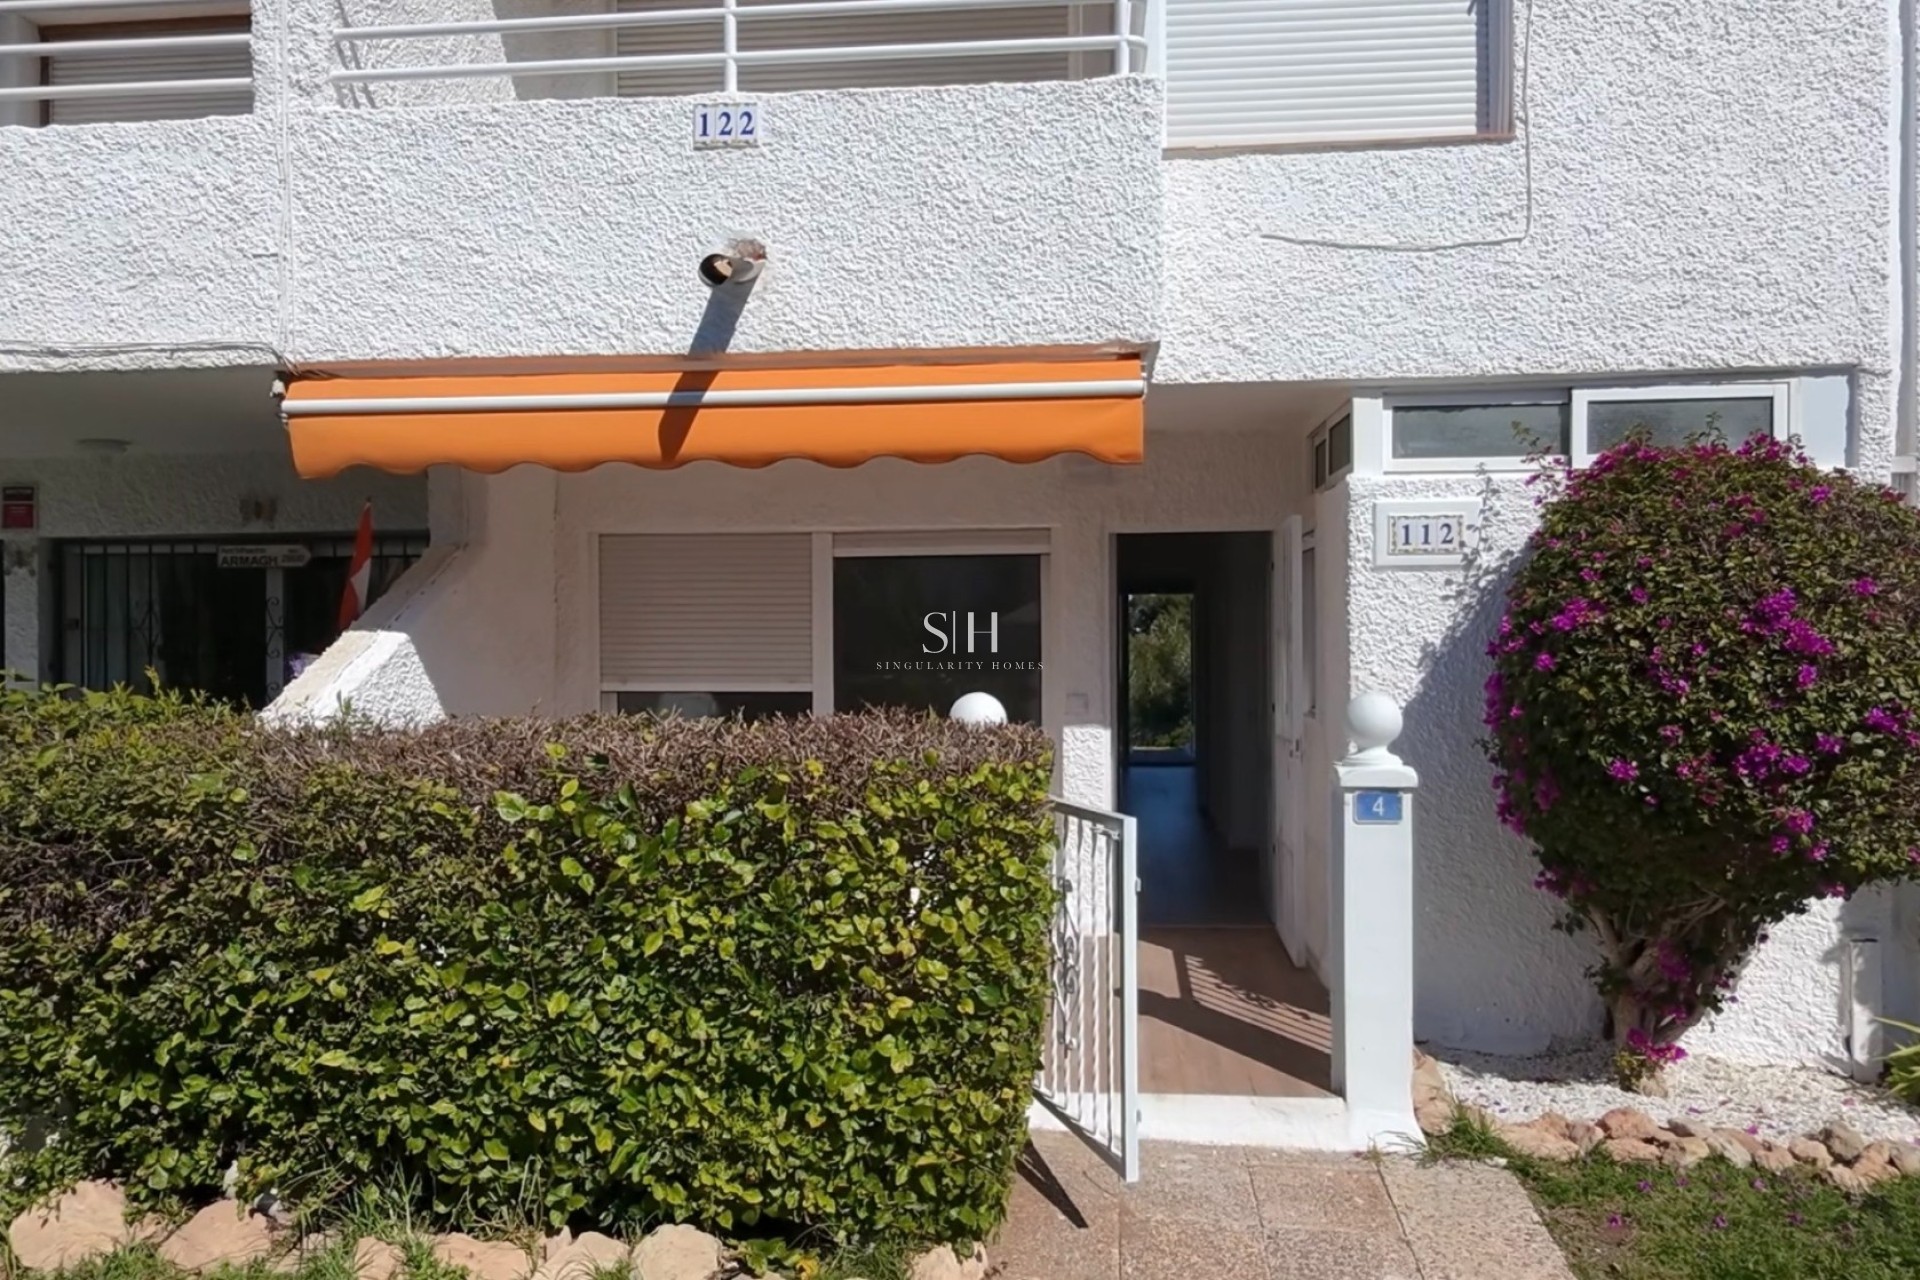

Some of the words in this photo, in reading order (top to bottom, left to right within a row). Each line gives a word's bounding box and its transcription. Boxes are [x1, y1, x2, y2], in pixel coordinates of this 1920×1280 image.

[699, 111, 755, 137] 122
[1402, 522, 1455, 546] 112
[221, 555, 279, 567] ARMAGH
[1372, 796, 1385, 817] 4
